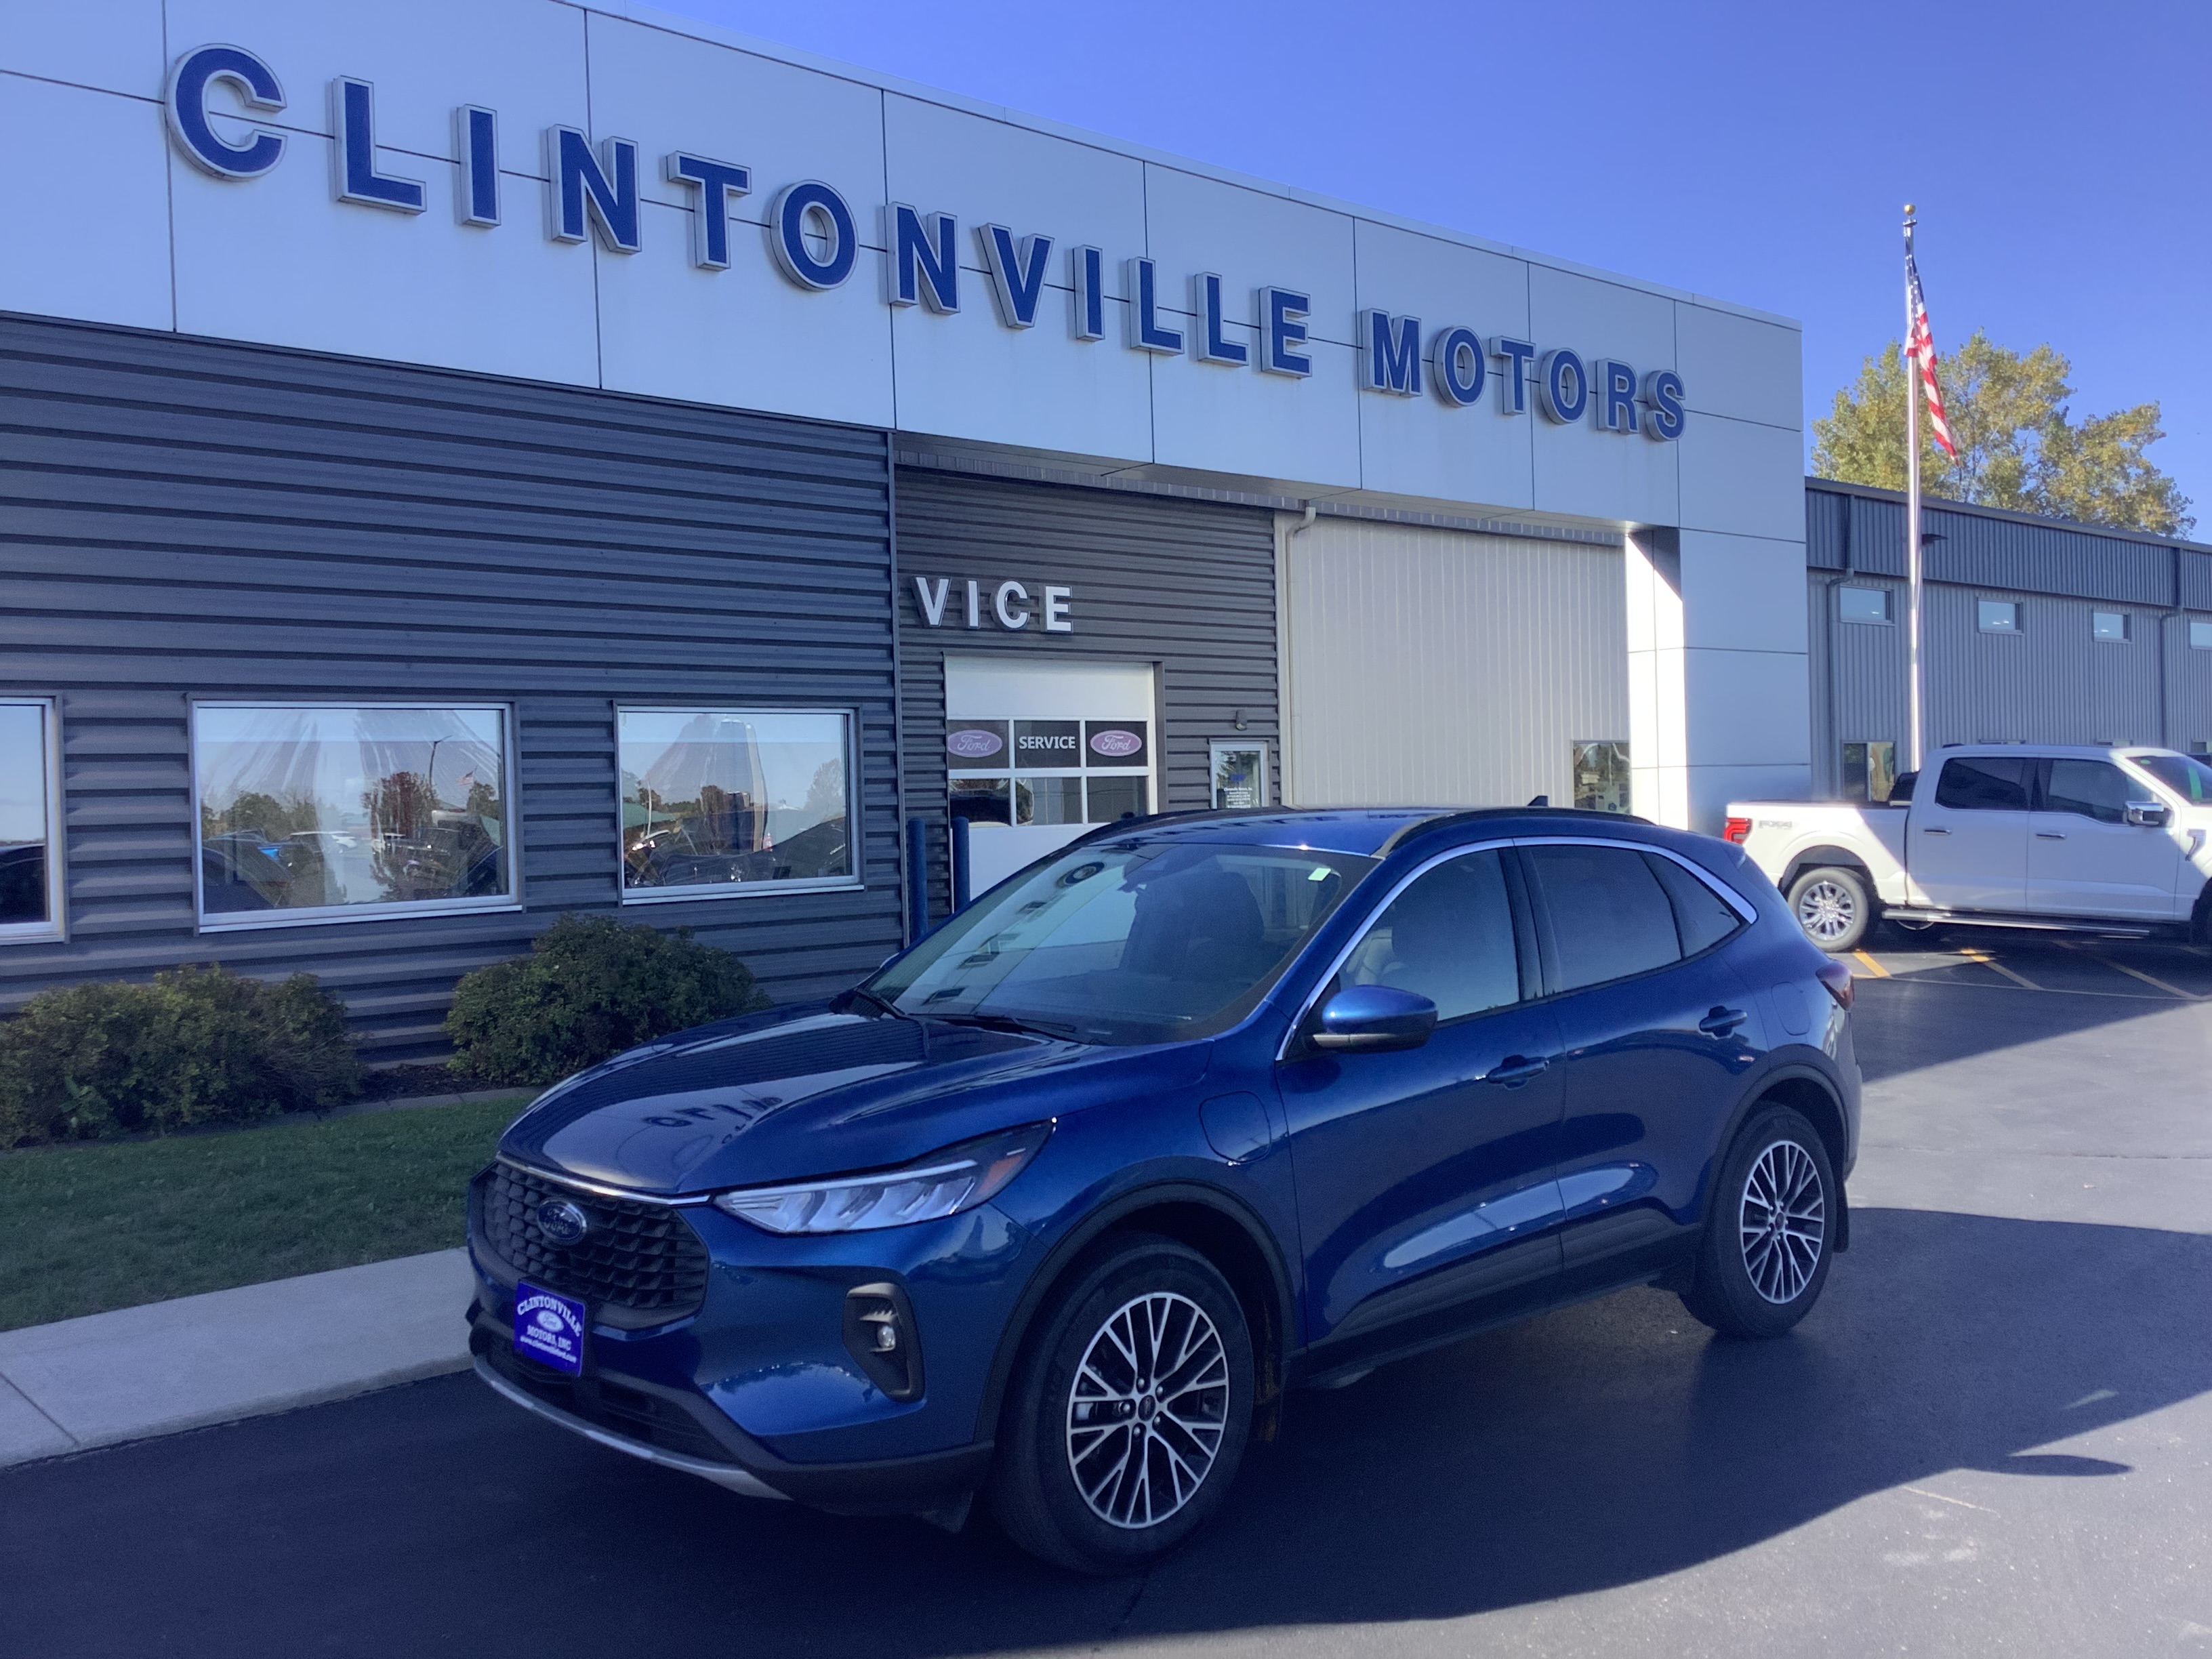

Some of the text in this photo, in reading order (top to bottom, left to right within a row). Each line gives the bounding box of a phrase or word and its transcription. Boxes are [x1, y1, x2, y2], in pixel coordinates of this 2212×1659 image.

[165, 42, 1685, 442] CLINTONVILLE MOTORS
[957, 735, 990, 752] Ford
[1019, 736, 1076, 750] SERVICE
[1101, 735, 1131, 751] Ford
[517, 1295, 582, 1337] CLINTONVILLE
